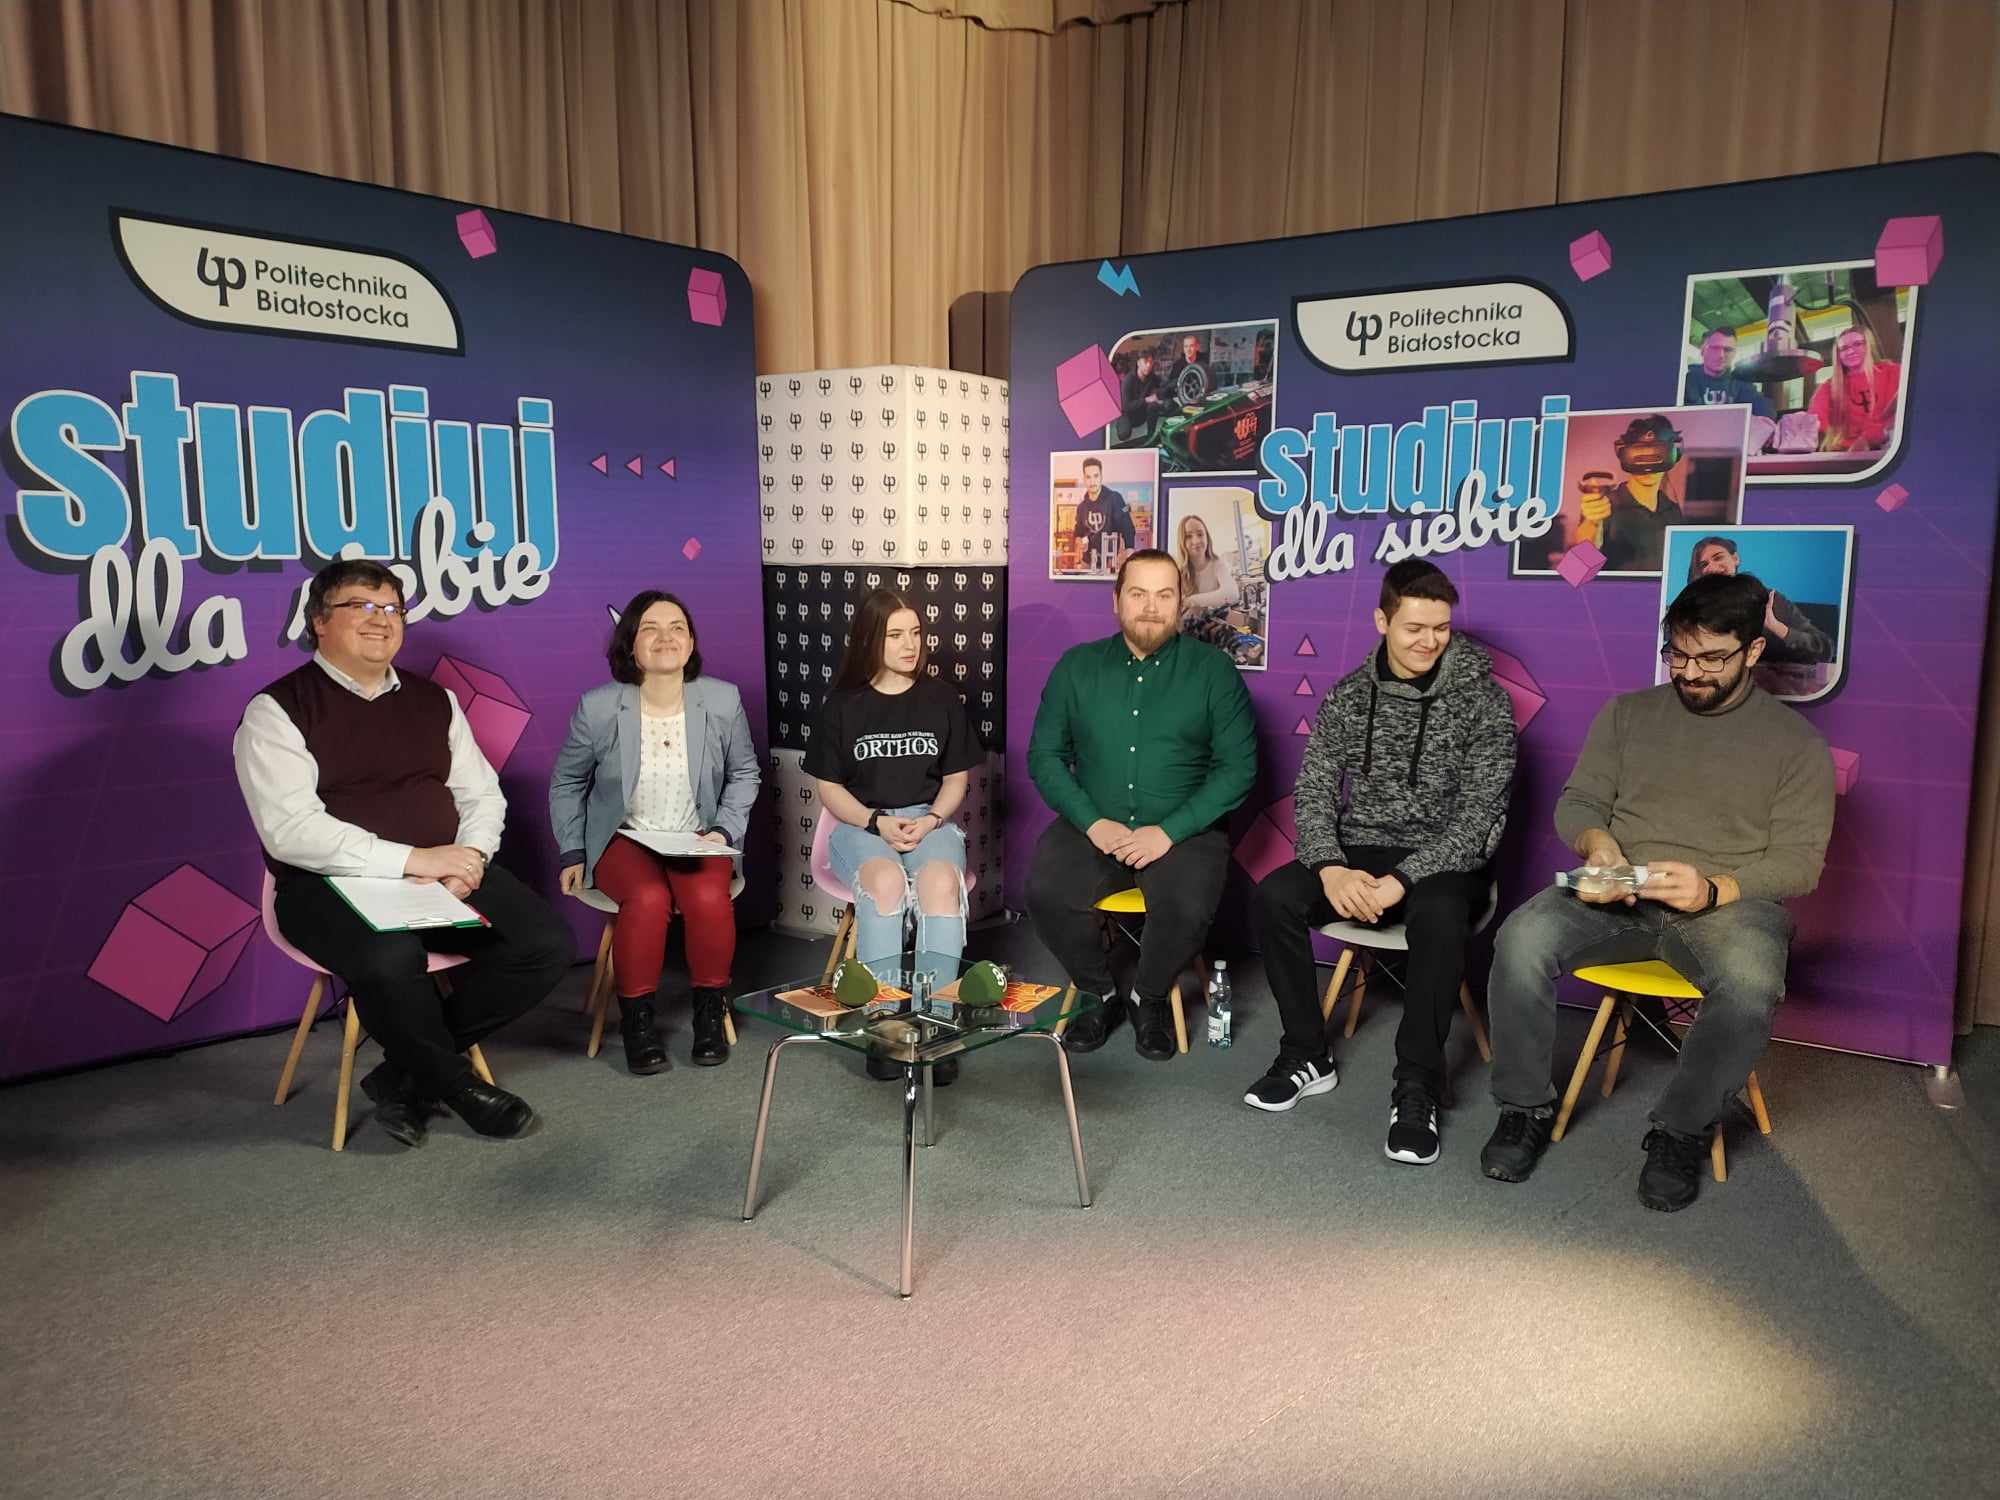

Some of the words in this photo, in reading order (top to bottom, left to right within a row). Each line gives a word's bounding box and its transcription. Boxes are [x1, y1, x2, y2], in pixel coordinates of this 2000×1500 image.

[255, 259, 408, 300] Politechnika
[256, 288, 409, 329] Białostocka
[1389, 301, 1523, 329] Politechnika
[1388, 328, 1521, 354] Białostocka
[10, 370, 559, 573] studiuj
[1259, 395, 1571, 520] studiuj
[1268, 500, 1354, 582] dla
[1374, 469, 1552, 564] siebie
[61, 537, 248, 690] dla
[853, 737, 939, 761] ORTHOS
